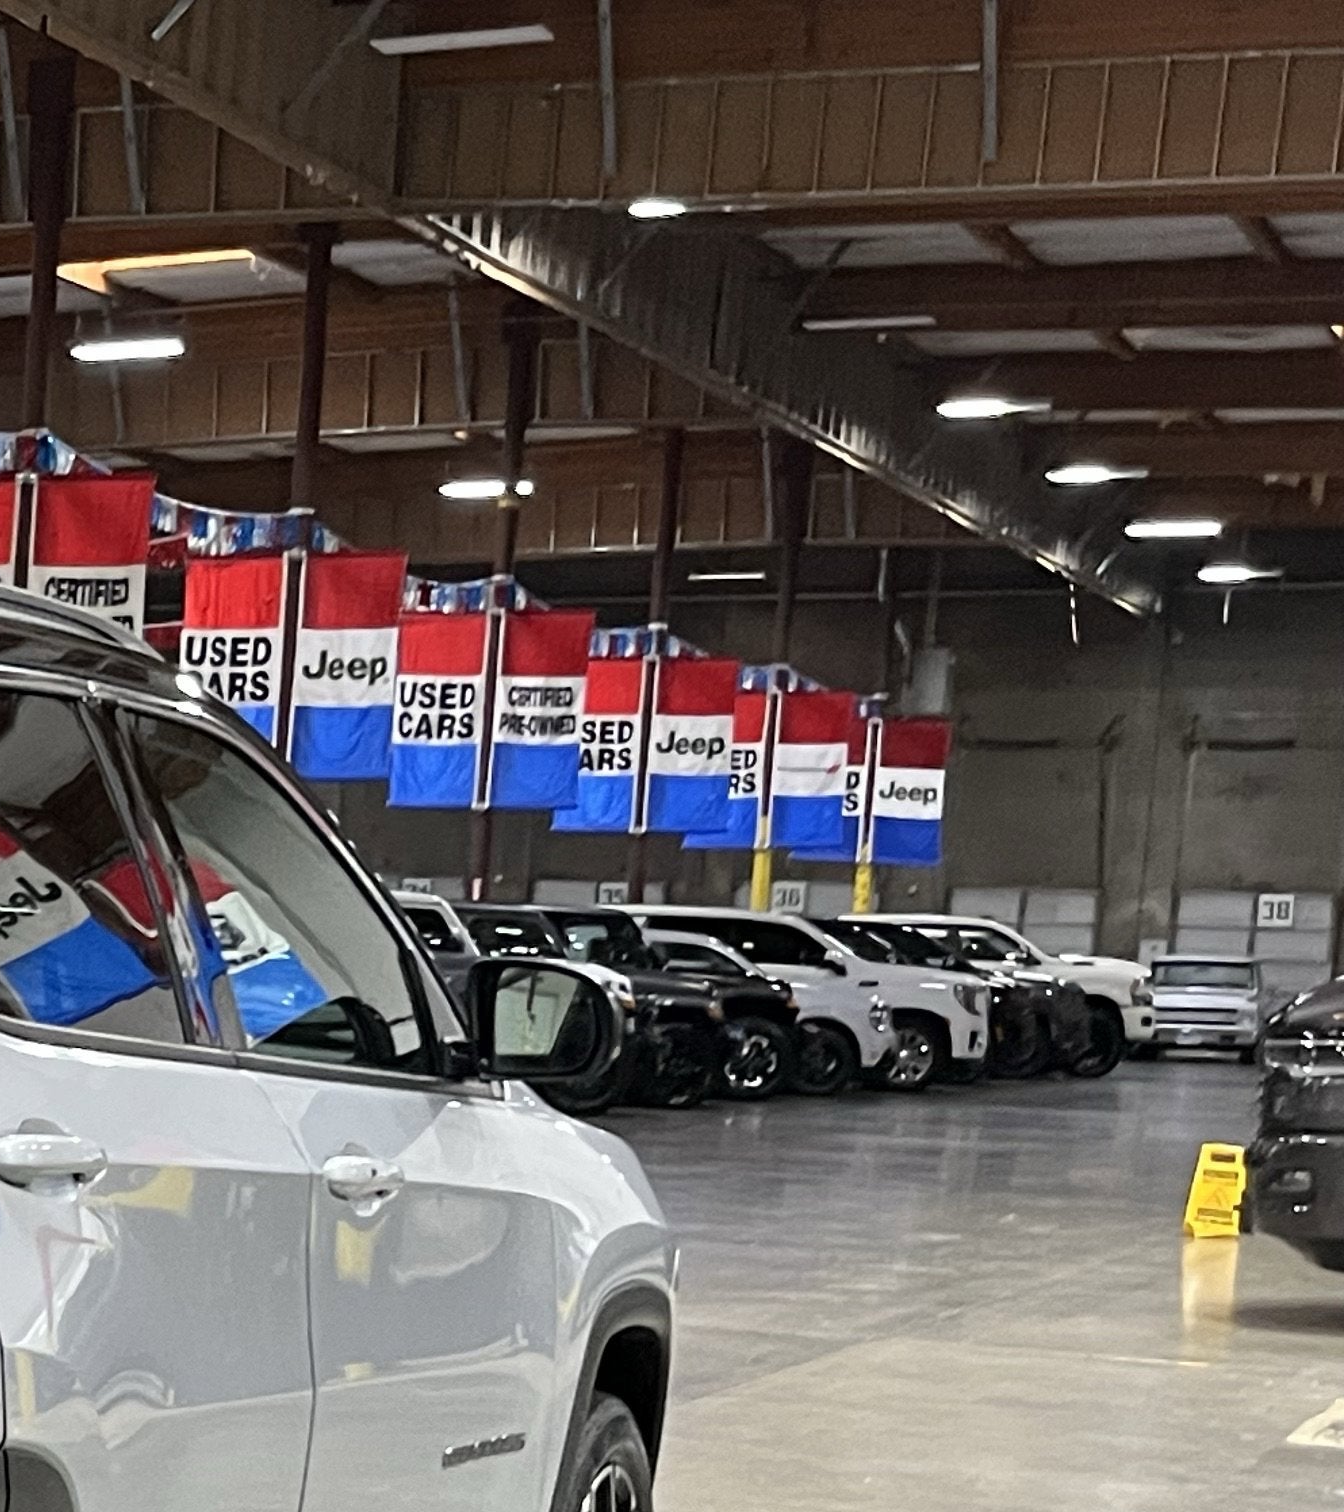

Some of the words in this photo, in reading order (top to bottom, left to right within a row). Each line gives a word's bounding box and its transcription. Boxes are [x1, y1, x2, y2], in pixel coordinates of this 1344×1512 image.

[44, 576, 129, 607] CERTIFIED
[184, 636, 272, 668] USED
[301, 650, 388, 686] Jeep
[208, 670, 270, 702] ARS
[400, 681, 476, 710] USED
[398, 711, 475, 740] CARS
[580, 720, 634, 745] SED
[579, 747, 632, 772] ARS
[655, 730, 725, 760] Jeep
[730, 749, 758, 771] ED
[728, 772, 757, 795] RS
[878, 781, 938, 806] Jeep
[1262, 901, 1291, 920] 38
